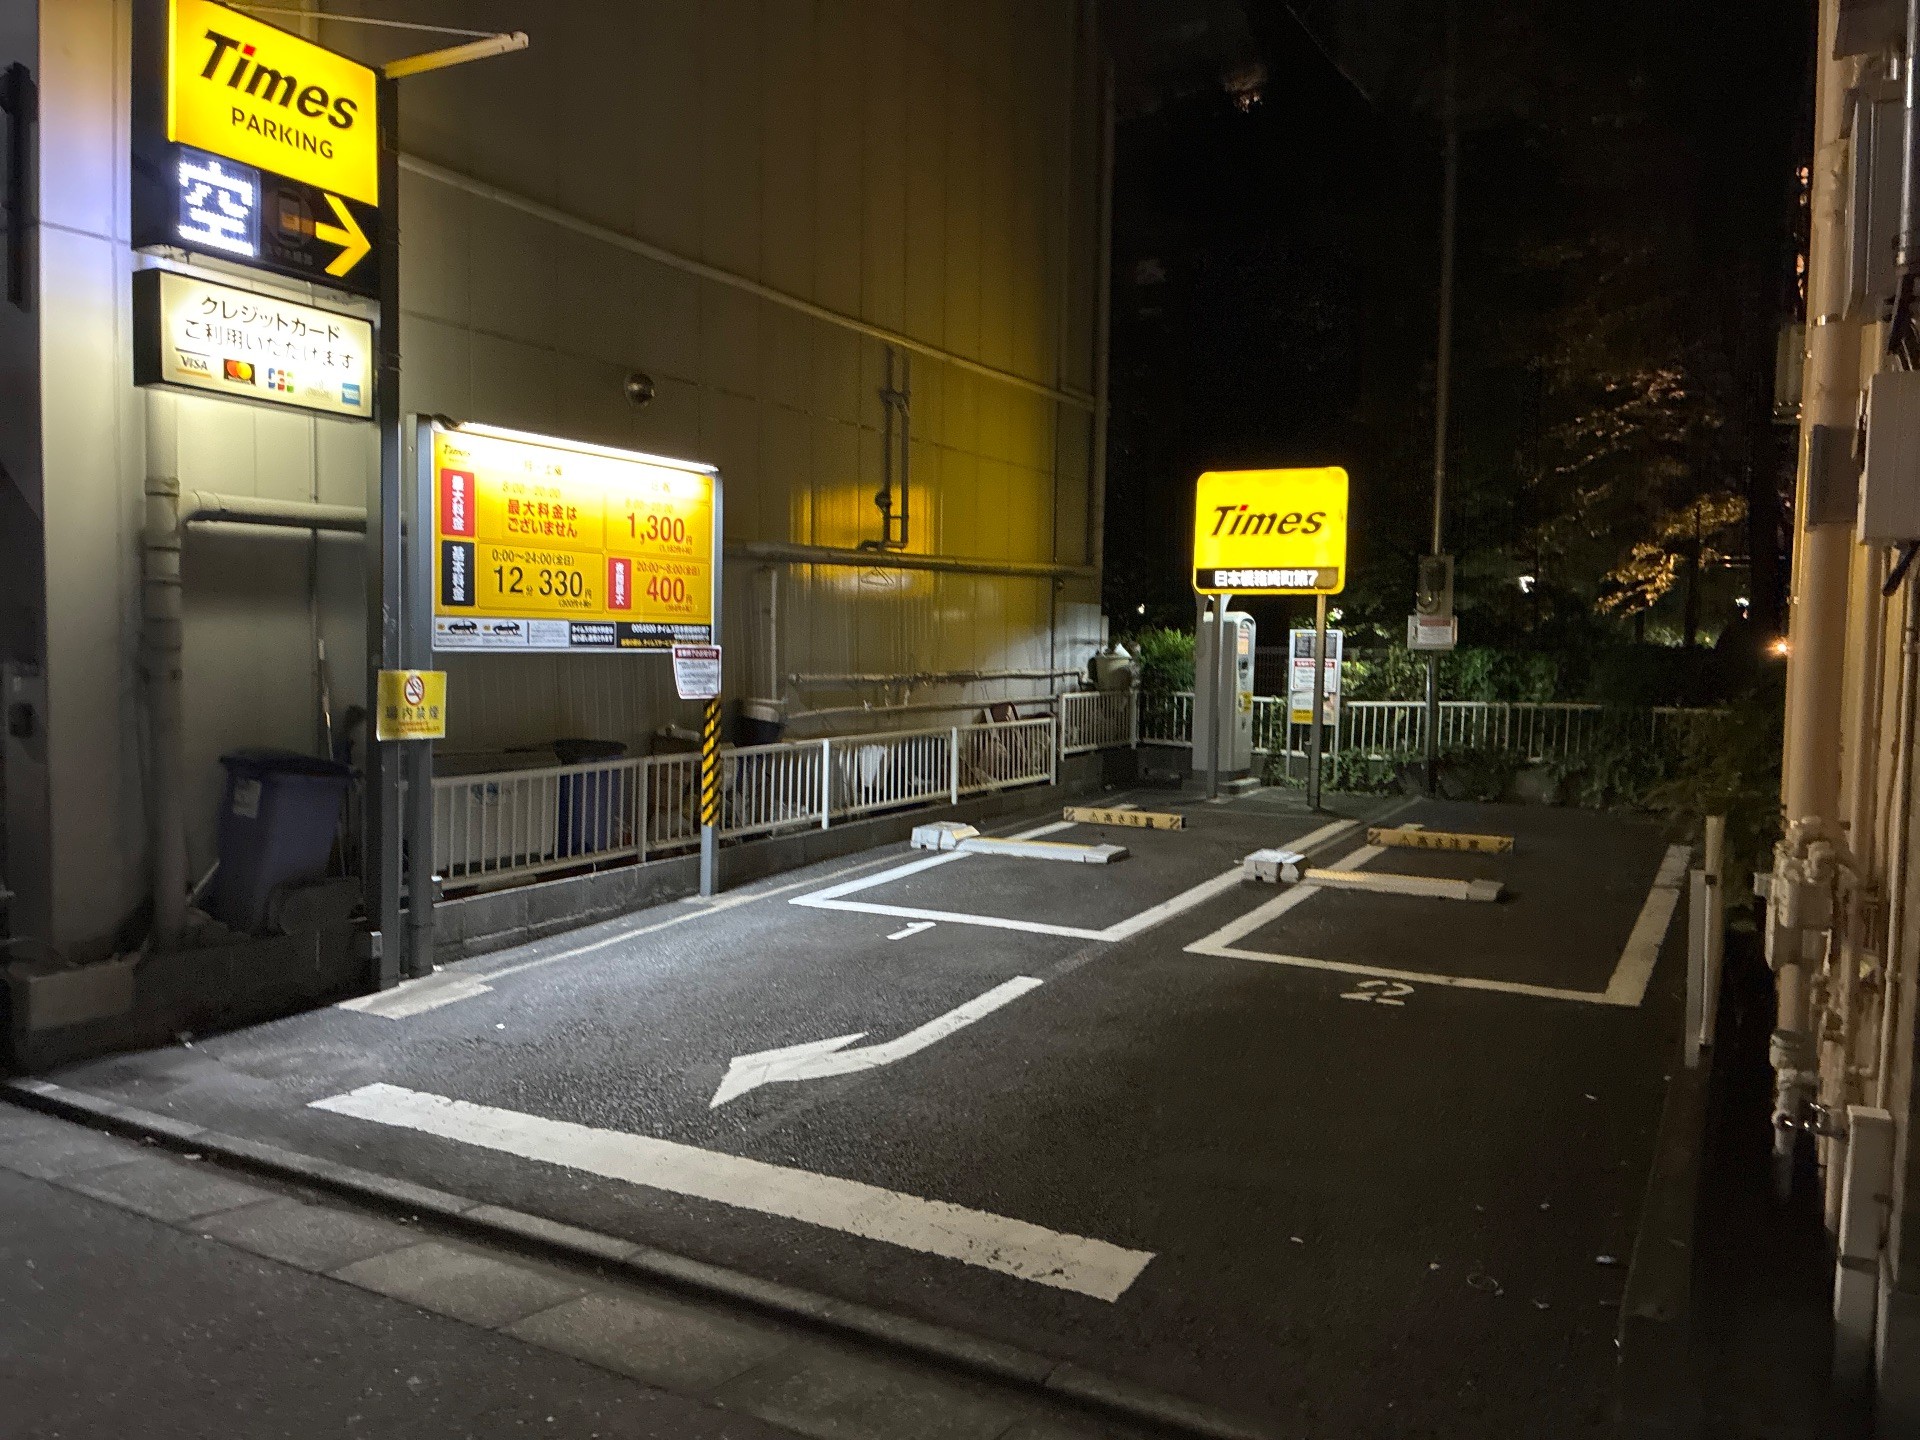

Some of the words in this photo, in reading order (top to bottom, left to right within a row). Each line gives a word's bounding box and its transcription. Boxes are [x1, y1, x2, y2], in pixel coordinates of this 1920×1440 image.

[200, 29, 358, 129] Times
[231, 106, 334, 160] PARKING
[177, 161, 254, 257] 空
[202, 296, 340, 342] クレジットカード
[180, 354, 208, 371] VISA
[508, 498, 578, 520] 最大料金は
[508, 517, 578, 538] ございません
[1211, 504, 1327, 537] Times
